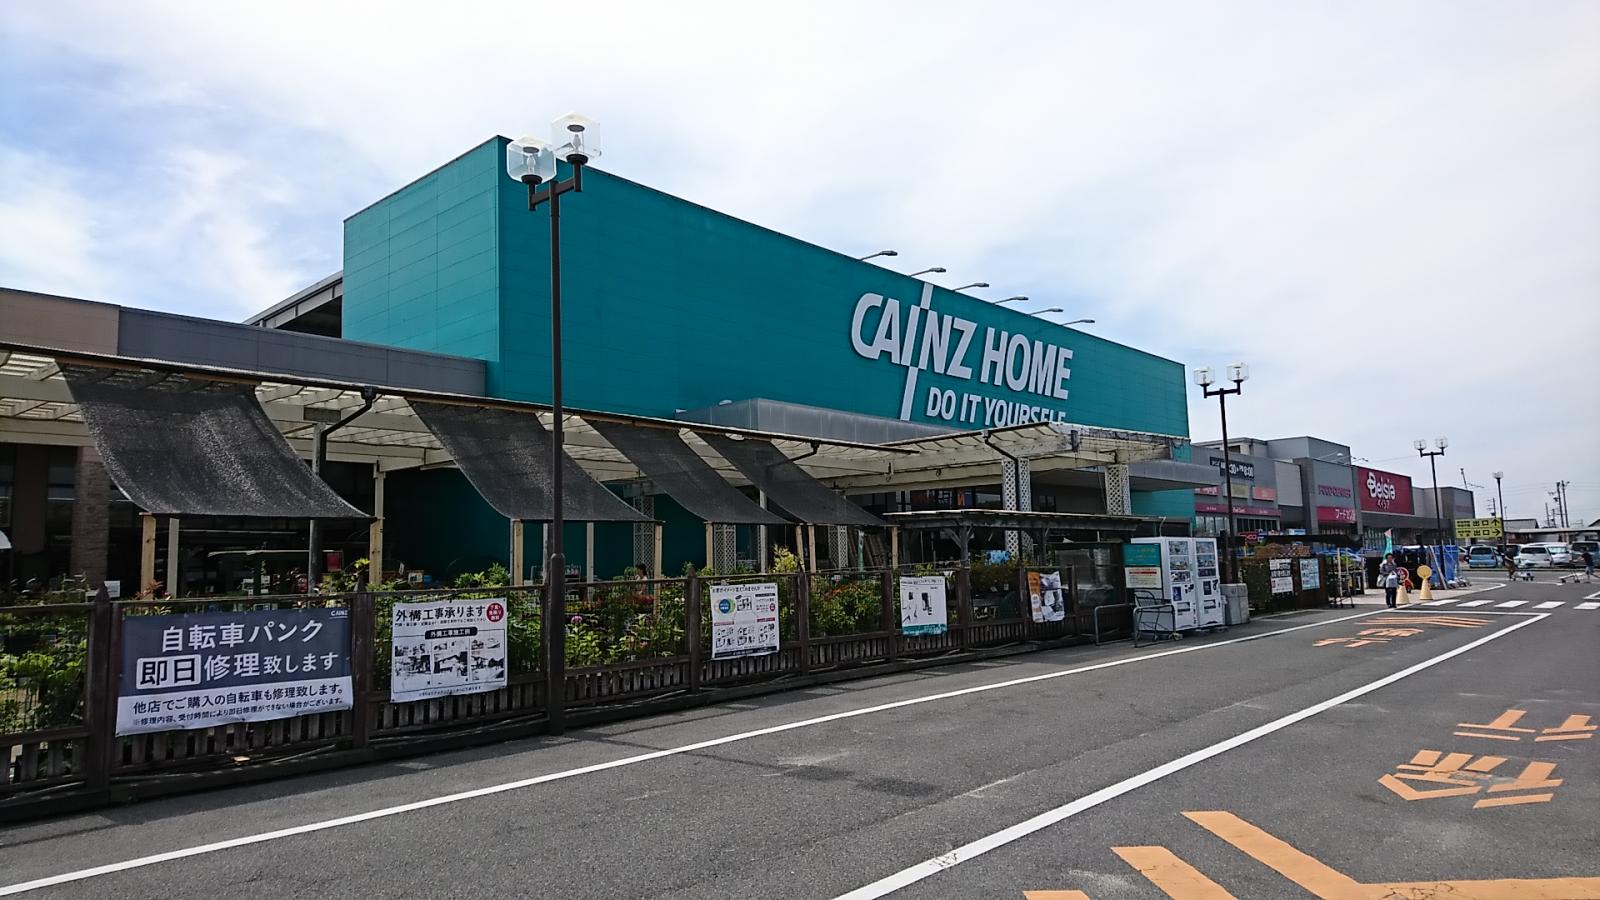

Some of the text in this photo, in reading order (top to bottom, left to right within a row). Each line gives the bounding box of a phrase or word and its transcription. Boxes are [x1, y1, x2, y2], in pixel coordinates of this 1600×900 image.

[851, 292, 1074, 400] CAINZ HOME
[926, 387, 957, 421] DO
[960, 393, 981, 424] IT
[395, 605, 486, 622] 外構工事承ります
[162, 620, 323, 652] 自転車パンク
[140, 652, 339, 685] 即日修理致します
[133, 683, 342, 715] 他店でご購入の自転車も修理致します。
